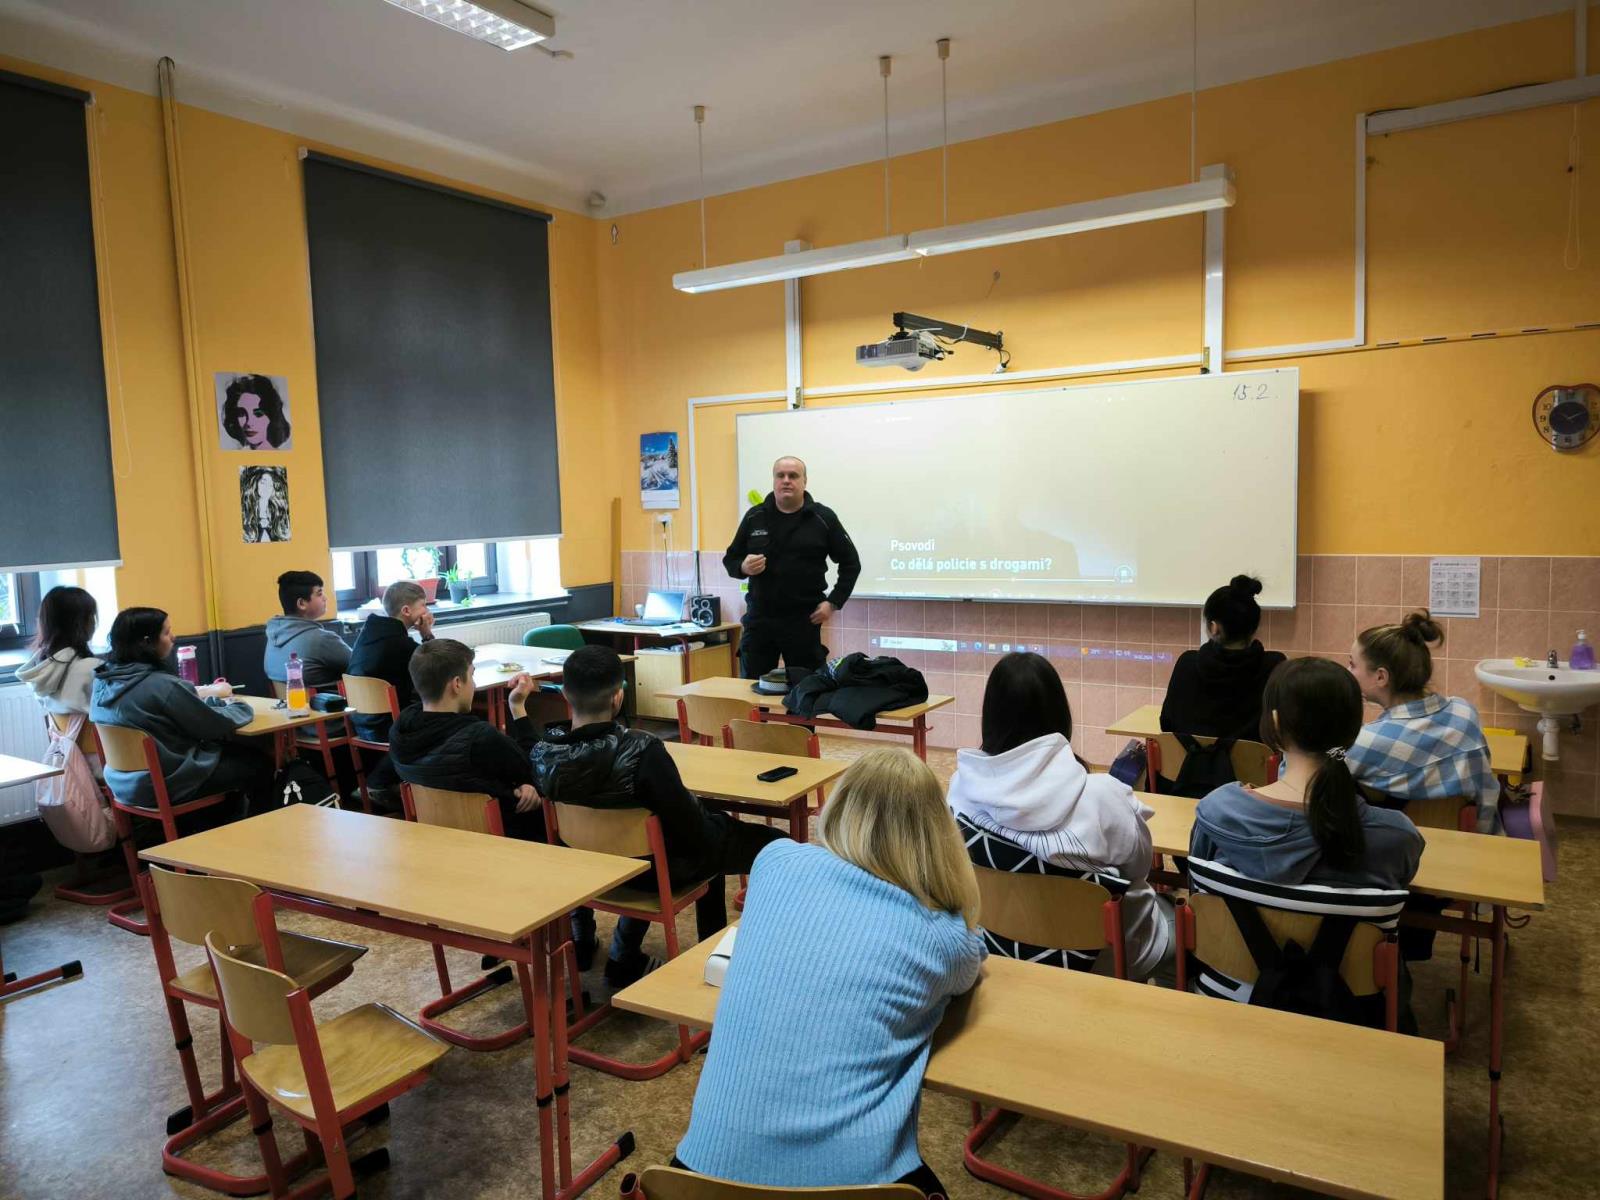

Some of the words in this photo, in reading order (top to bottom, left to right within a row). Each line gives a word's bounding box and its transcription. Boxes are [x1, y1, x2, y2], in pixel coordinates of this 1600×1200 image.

[890, 558, 905, 570] Co
[908, 558, 933, 570] dělá
[936, 558, 976, 573] policie
[979, 561, 987, 570] s
[989, 557, 1052, 573] drogami?
